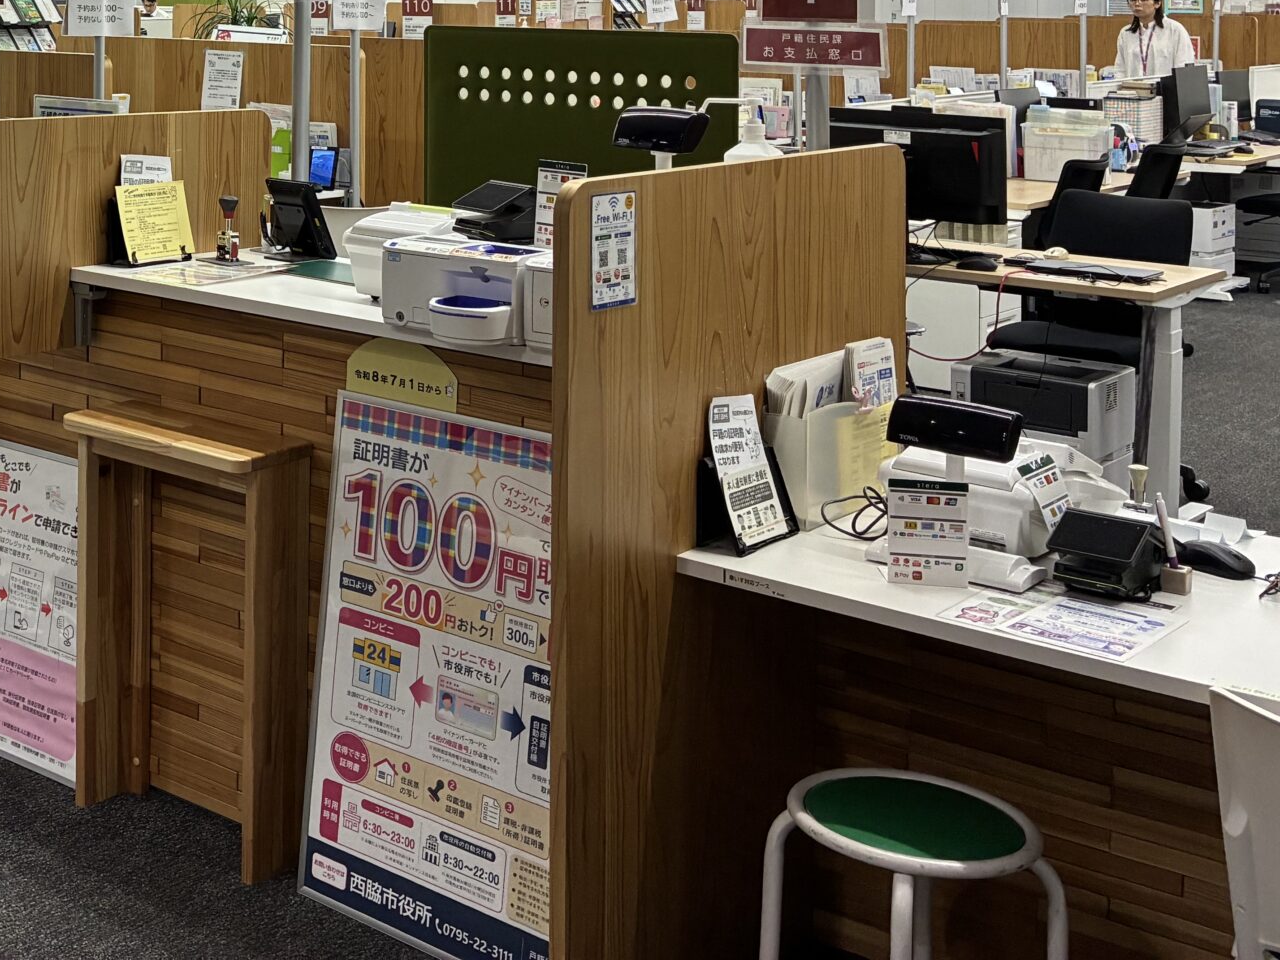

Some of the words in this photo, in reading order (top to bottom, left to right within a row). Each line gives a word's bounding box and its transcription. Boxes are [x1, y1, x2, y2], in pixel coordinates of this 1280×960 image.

[404, 0, 430, 13] 110
[782, 33, 842, 44] 戸籍住民課
[353, 438, 430, 474] 証明書が
[4, 461, 32, 472] どこでも
[342, 577, 374, 593] 窓口よりも
[363, 619, 395, 635] コンビニ
[367, 643, 387, 664] 24
[334, 743, 367, 763] 取得できる
[349, 871, 433, 928] 西脇市役所
[443, 923, 513, 960] 0795-22-3111
